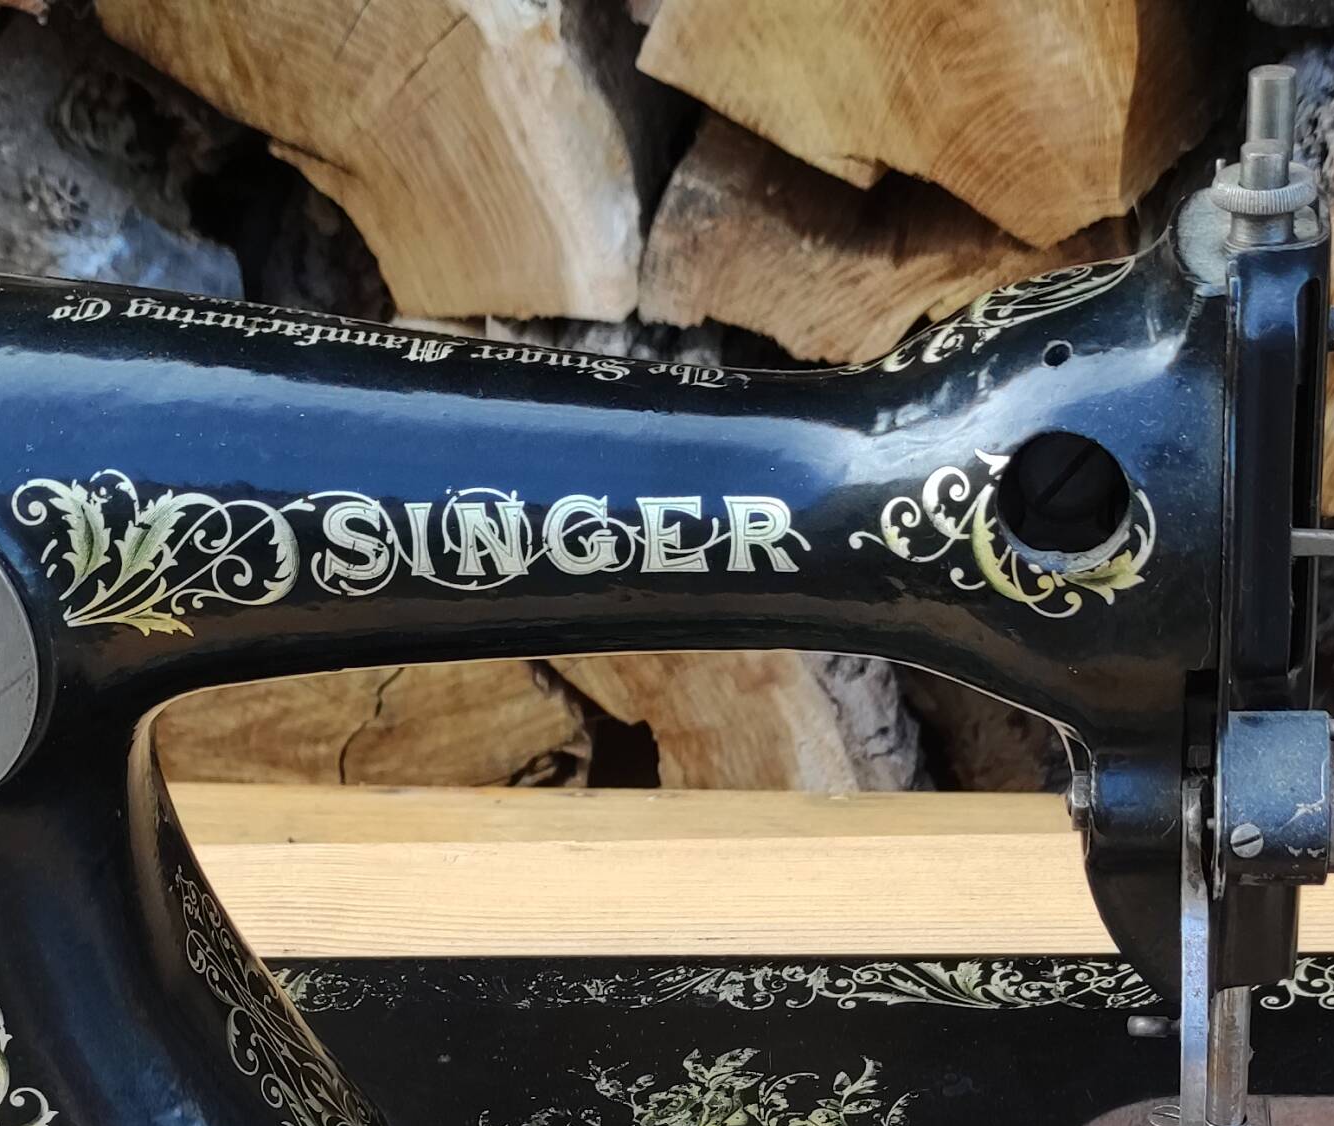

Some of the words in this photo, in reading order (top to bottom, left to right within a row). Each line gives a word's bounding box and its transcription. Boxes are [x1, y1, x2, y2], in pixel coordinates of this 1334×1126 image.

[120, 297, 467, 362] Manufacturing
[470, 345, 636, 381] Singer
[647, 362, 728, 389] The
[322, 494, 801, 581] SINGER
